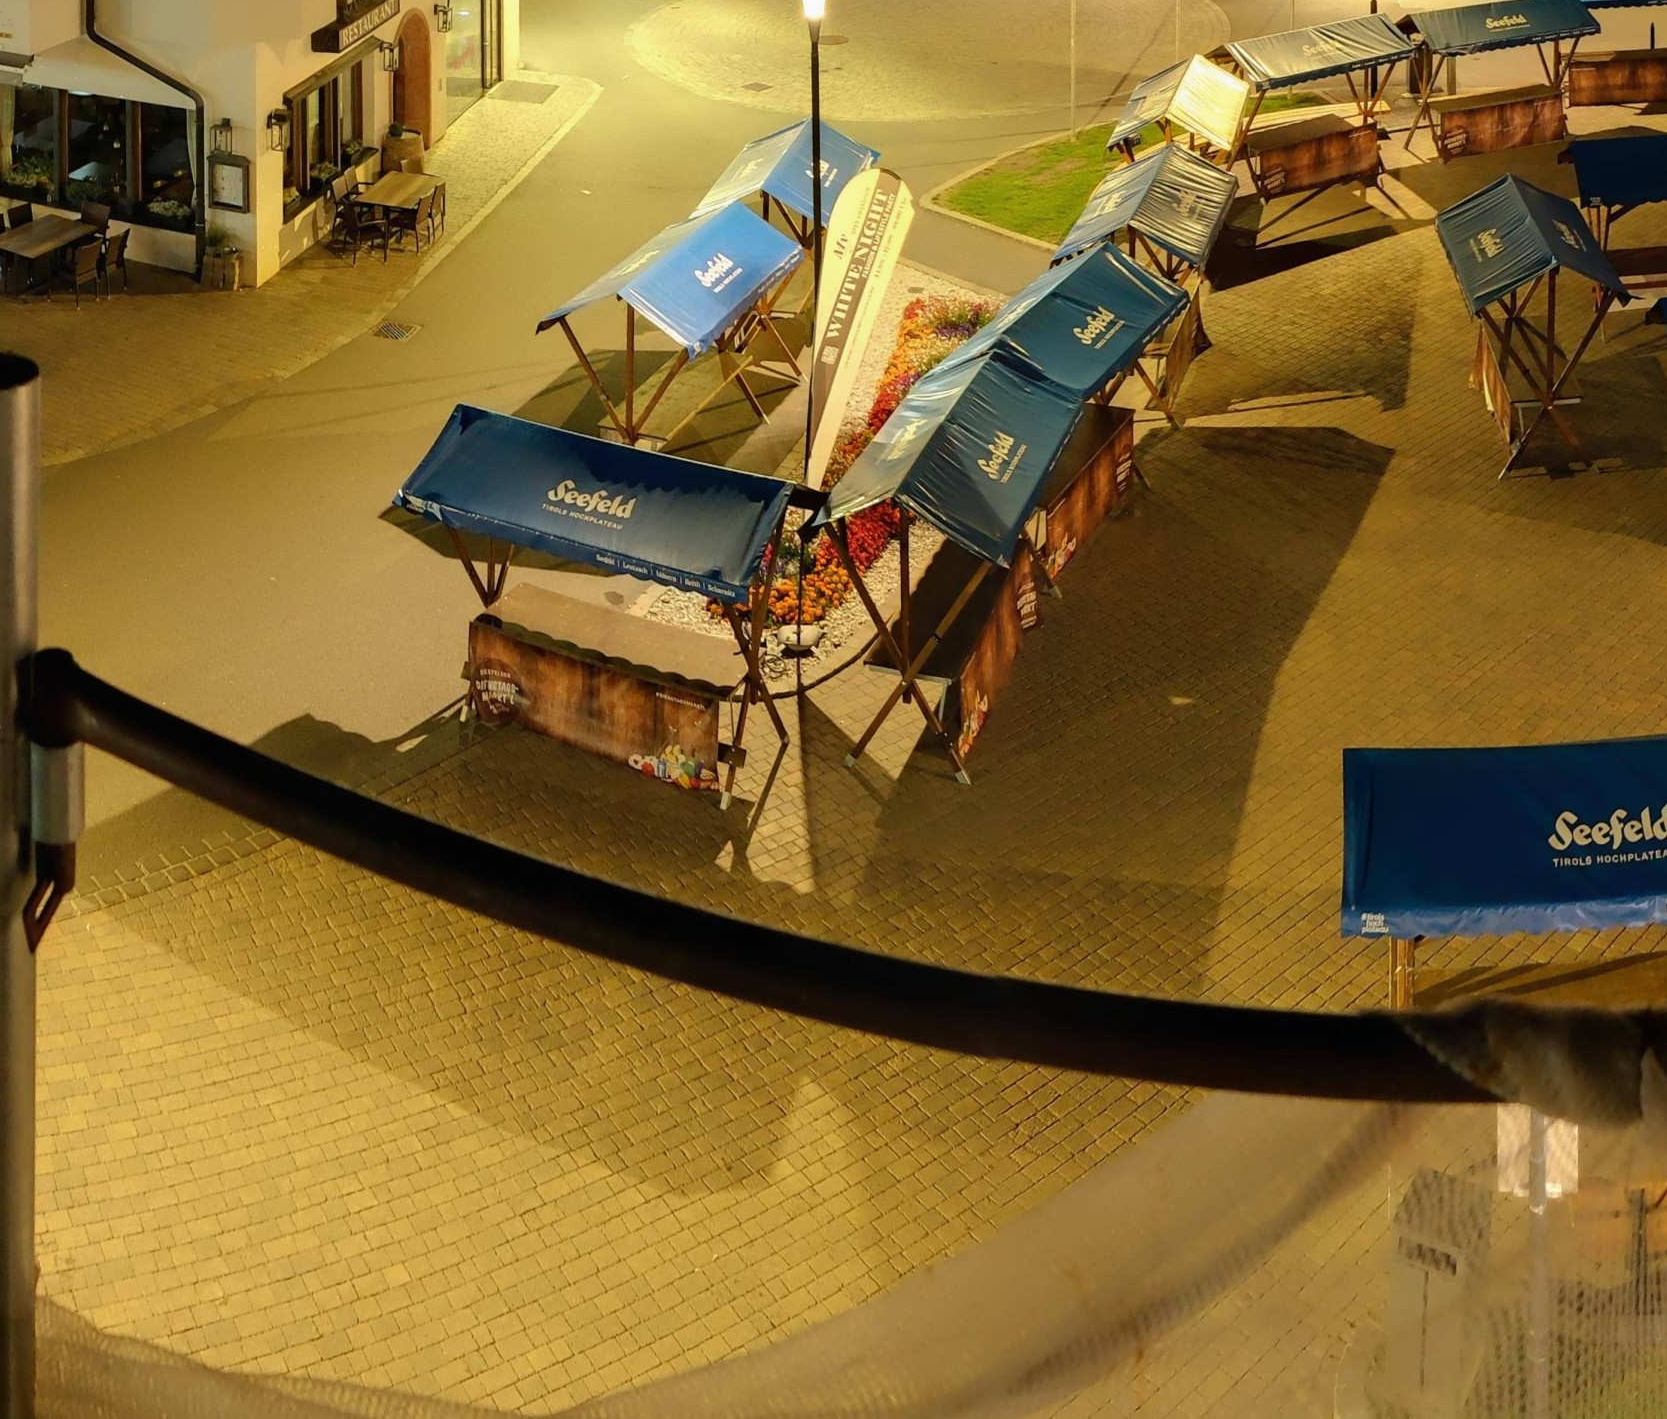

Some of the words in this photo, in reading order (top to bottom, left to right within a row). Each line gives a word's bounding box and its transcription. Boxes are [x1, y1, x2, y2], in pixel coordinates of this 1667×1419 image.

[1485, 13, 1527, 30] Seefeld
[695, 252, 734, 288] Seefeld
[826, 262, 864, 342] WHITE
[853, 187, 890, 261] NIGHT
[1073, 306, 1116, 345] Seefeld
[977, 431, 1016, 480] Seefeld
[547, 479, 638, 520] Seefeld
[540, 502, 569, 516] TIROLS
[568, 510, 624, 531] HOCHPLATEAU
[1553, 857, 1592, 868] TIROLS
[1361, 913, 1385, 922] #tirols
[1361, 926, 1390, 936] plateau
